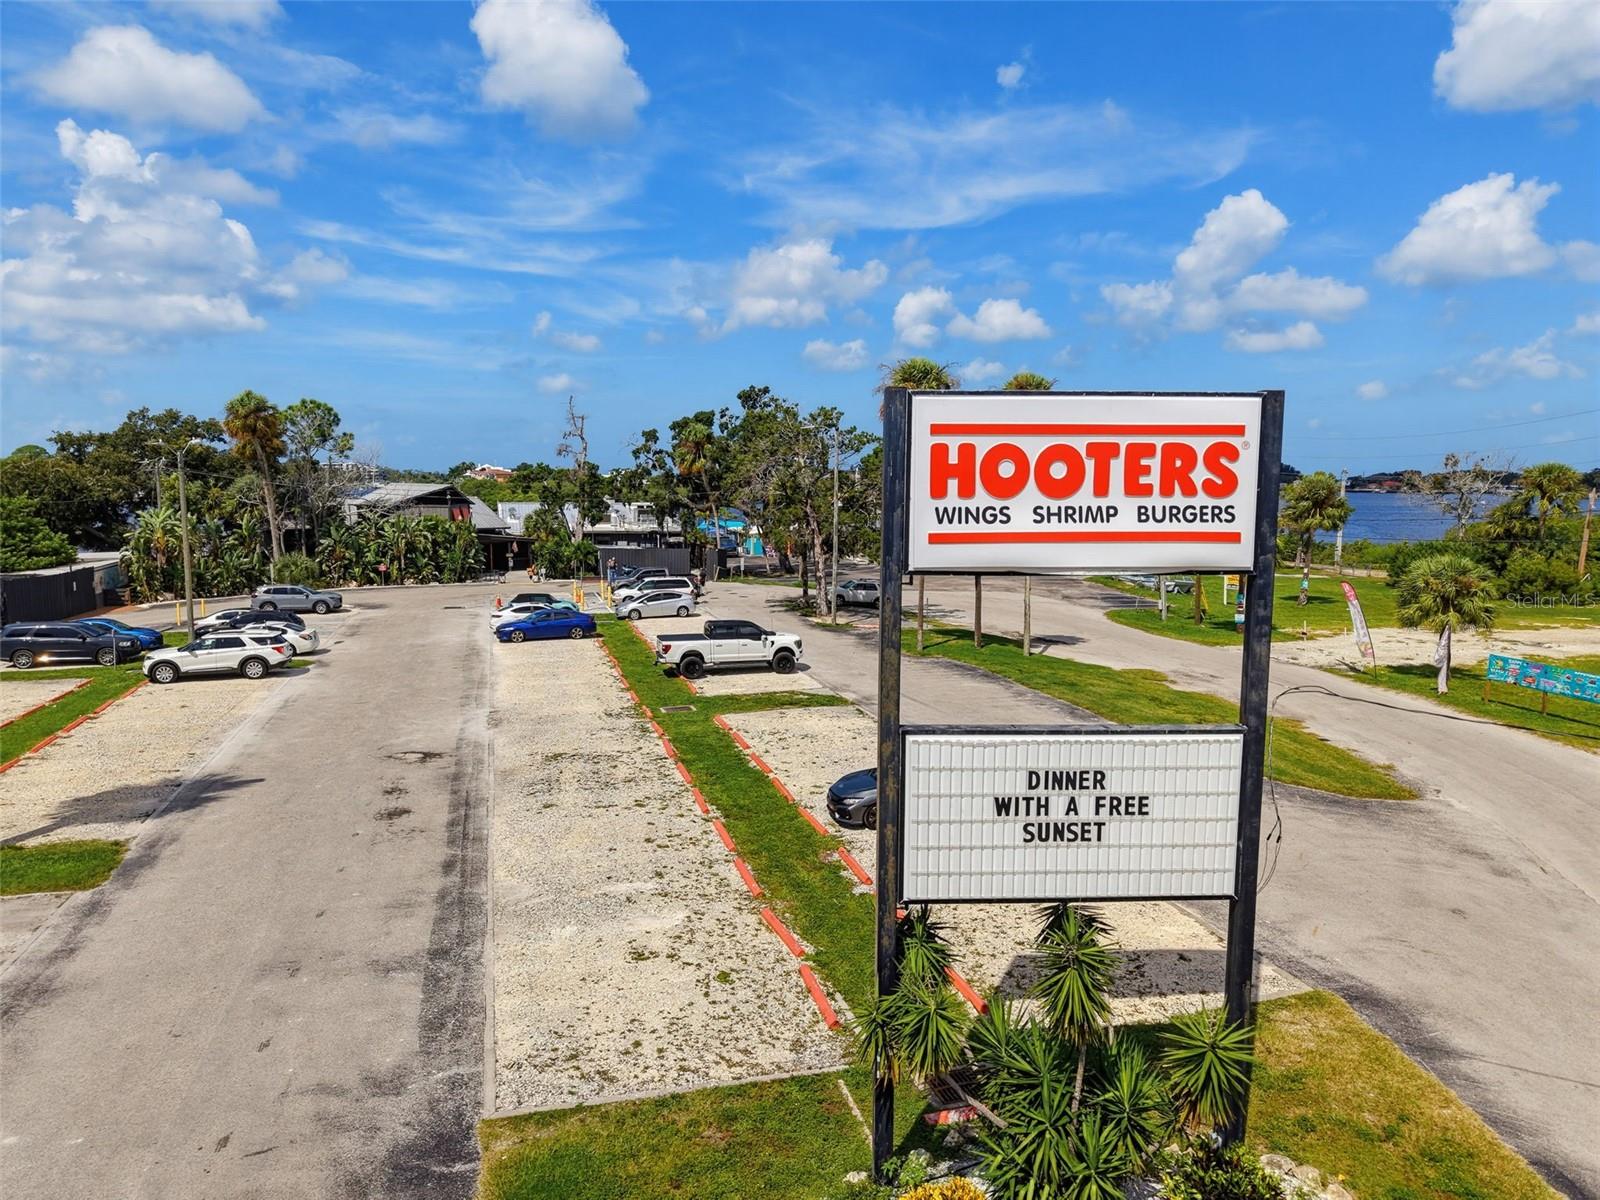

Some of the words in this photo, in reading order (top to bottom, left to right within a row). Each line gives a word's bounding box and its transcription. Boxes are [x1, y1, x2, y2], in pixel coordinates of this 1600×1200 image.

[929, 441, 1240, 500] HOOTERS
[934, 505, 1012, 525] WINGS
[1032, 504, 1119, 524] SHRIMP
[1136, 504, 1236, 524] BURGERS
[1027, 770, 1106, 791] DINNER
[994, 796, 1050, 817] WITH
[1064, 796, 1079, 816] A
[1094, 796, 1150, 816] FREE
[1022, 821, 1106, 843] SUNSET
